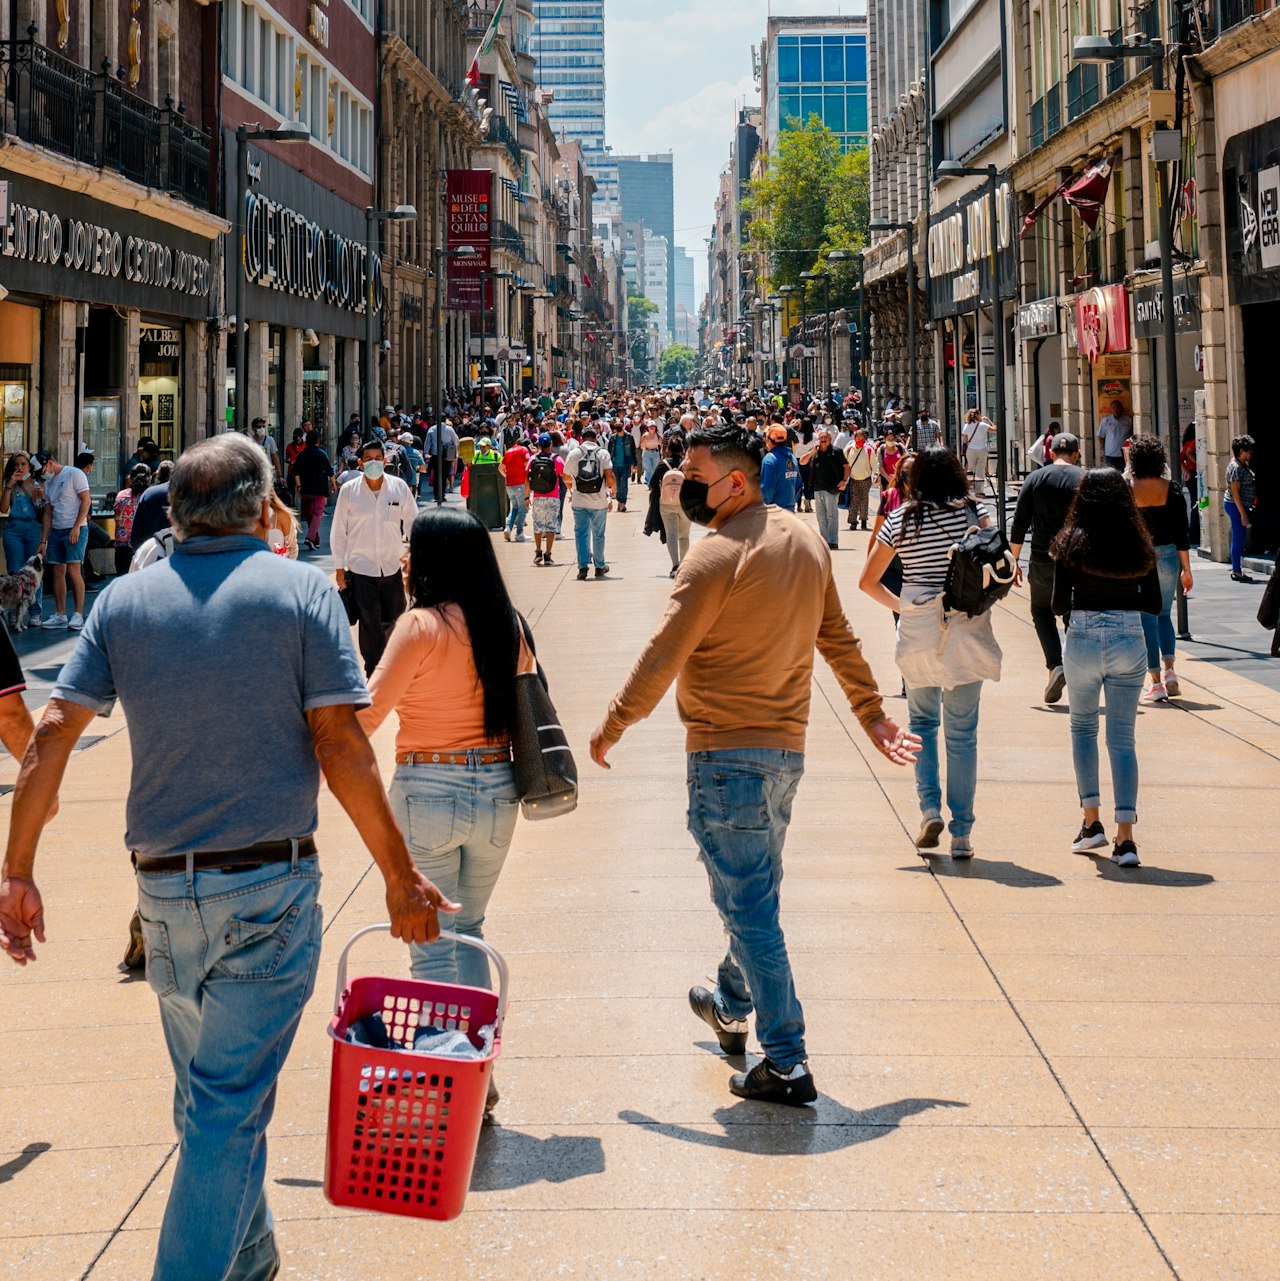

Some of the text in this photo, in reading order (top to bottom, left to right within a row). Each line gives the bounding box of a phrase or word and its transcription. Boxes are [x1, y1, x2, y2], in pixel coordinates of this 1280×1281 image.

[460, 204, 480, 213] DEL
[1261, 187, 1279, 218] NEW
[451, 213, 487, 223] ESTAN
[1261, 217, 1280, 247] ERA
[64, 219, 122, 278] JOYERO
[124, 235, 171, 288] CENTRO
[171, 249, 211, 297] JOYERO
[245, 189, 382, 317] CENTRO JOYEO
